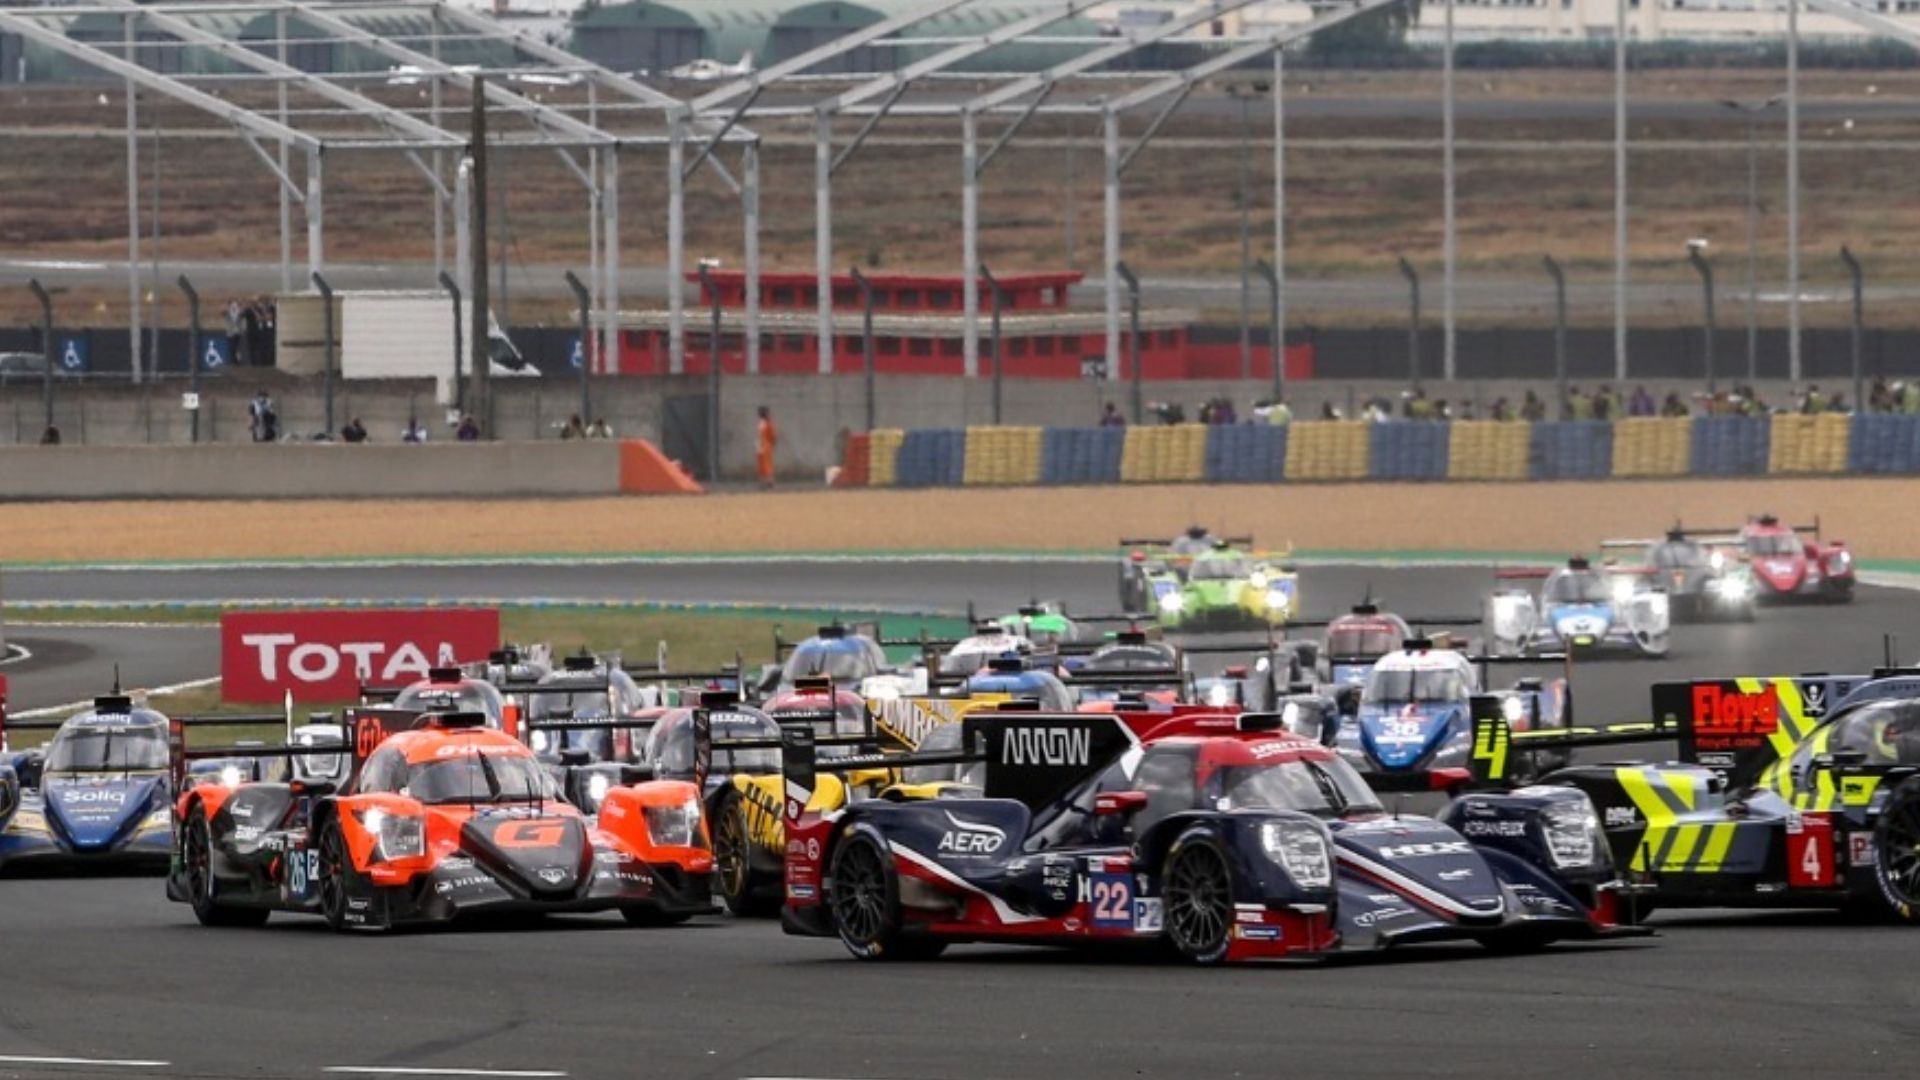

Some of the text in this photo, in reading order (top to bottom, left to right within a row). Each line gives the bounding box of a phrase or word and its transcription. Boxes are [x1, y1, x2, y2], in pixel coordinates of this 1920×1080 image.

[1692, 683, 1778, 733] Floyd
[1473, 718, 1508, 779] 4
[63, 790, 126, 805] Soliq
[937, 830, 1004, 853] AERO
[1802, 836, 1821, 881] 4
[1094, 881, 1131, 920] 22
[1137, 901, 1160, 927] P2
